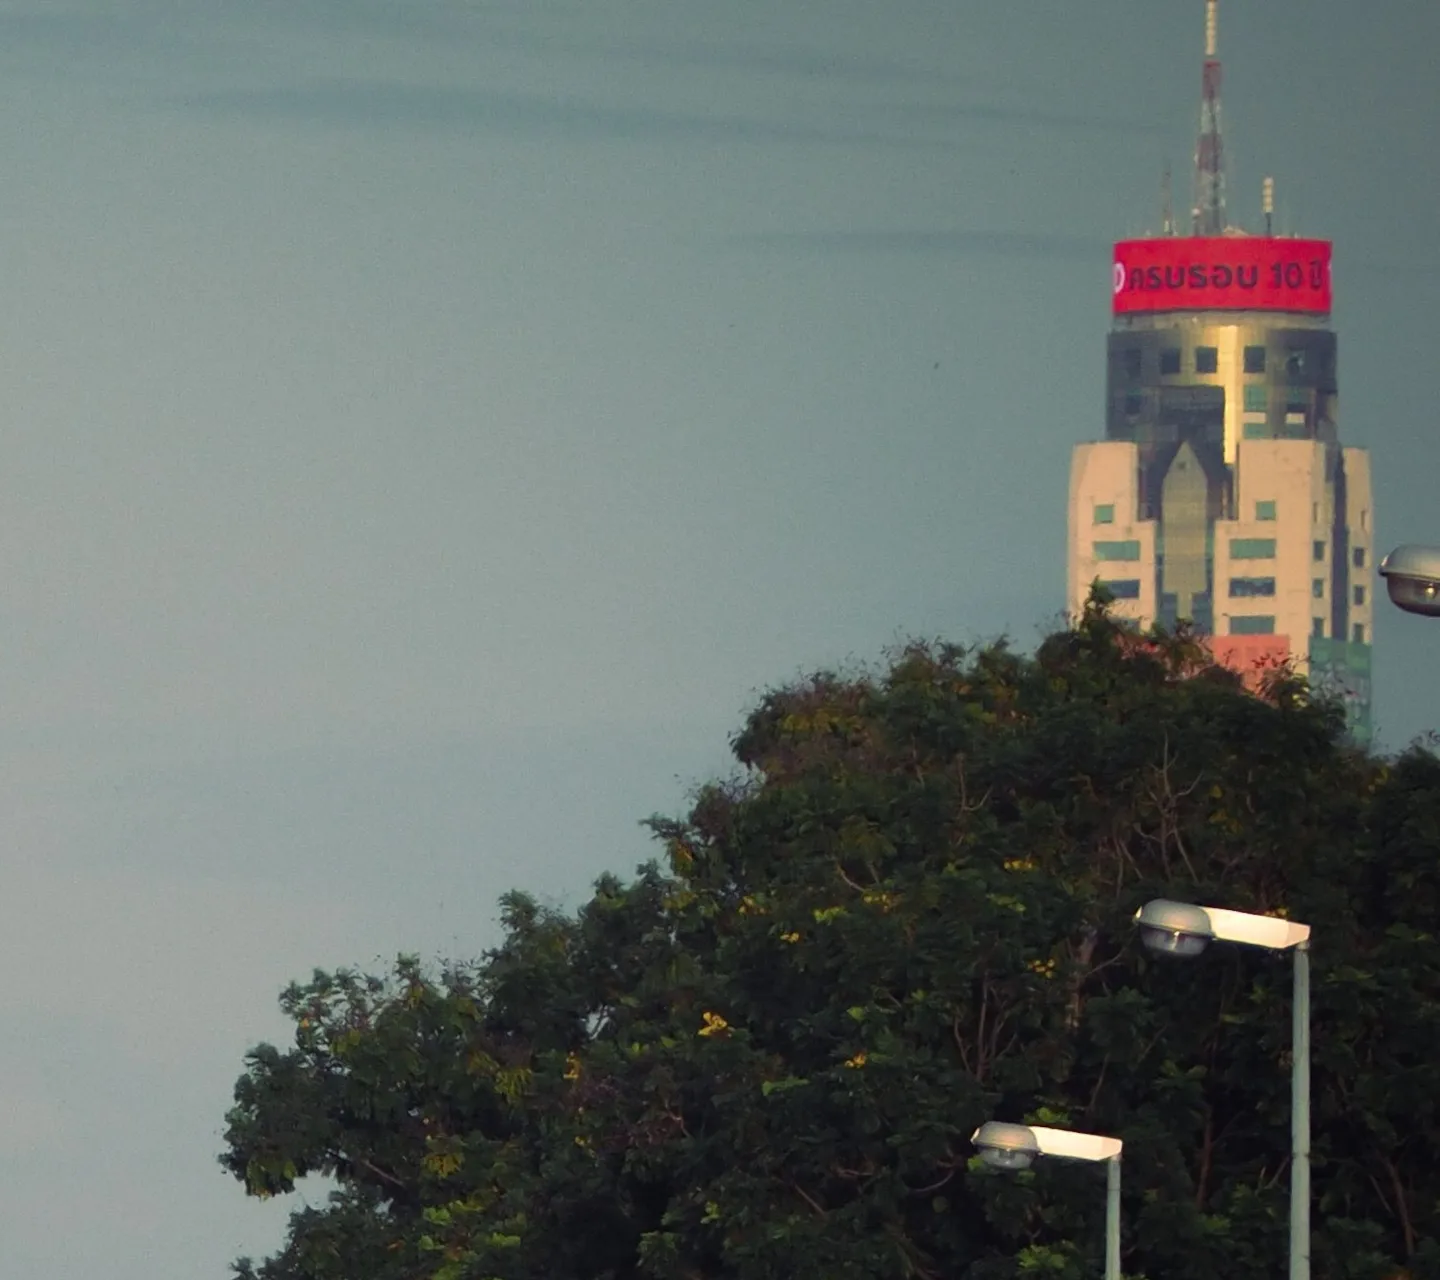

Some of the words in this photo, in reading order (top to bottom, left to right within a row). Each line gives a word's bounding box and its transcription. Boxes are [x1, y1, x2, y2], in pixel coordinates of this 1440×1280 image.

[1128, 263, 1258, 290] ครบรอบ
[1271, 261, 1303, 290] 10
